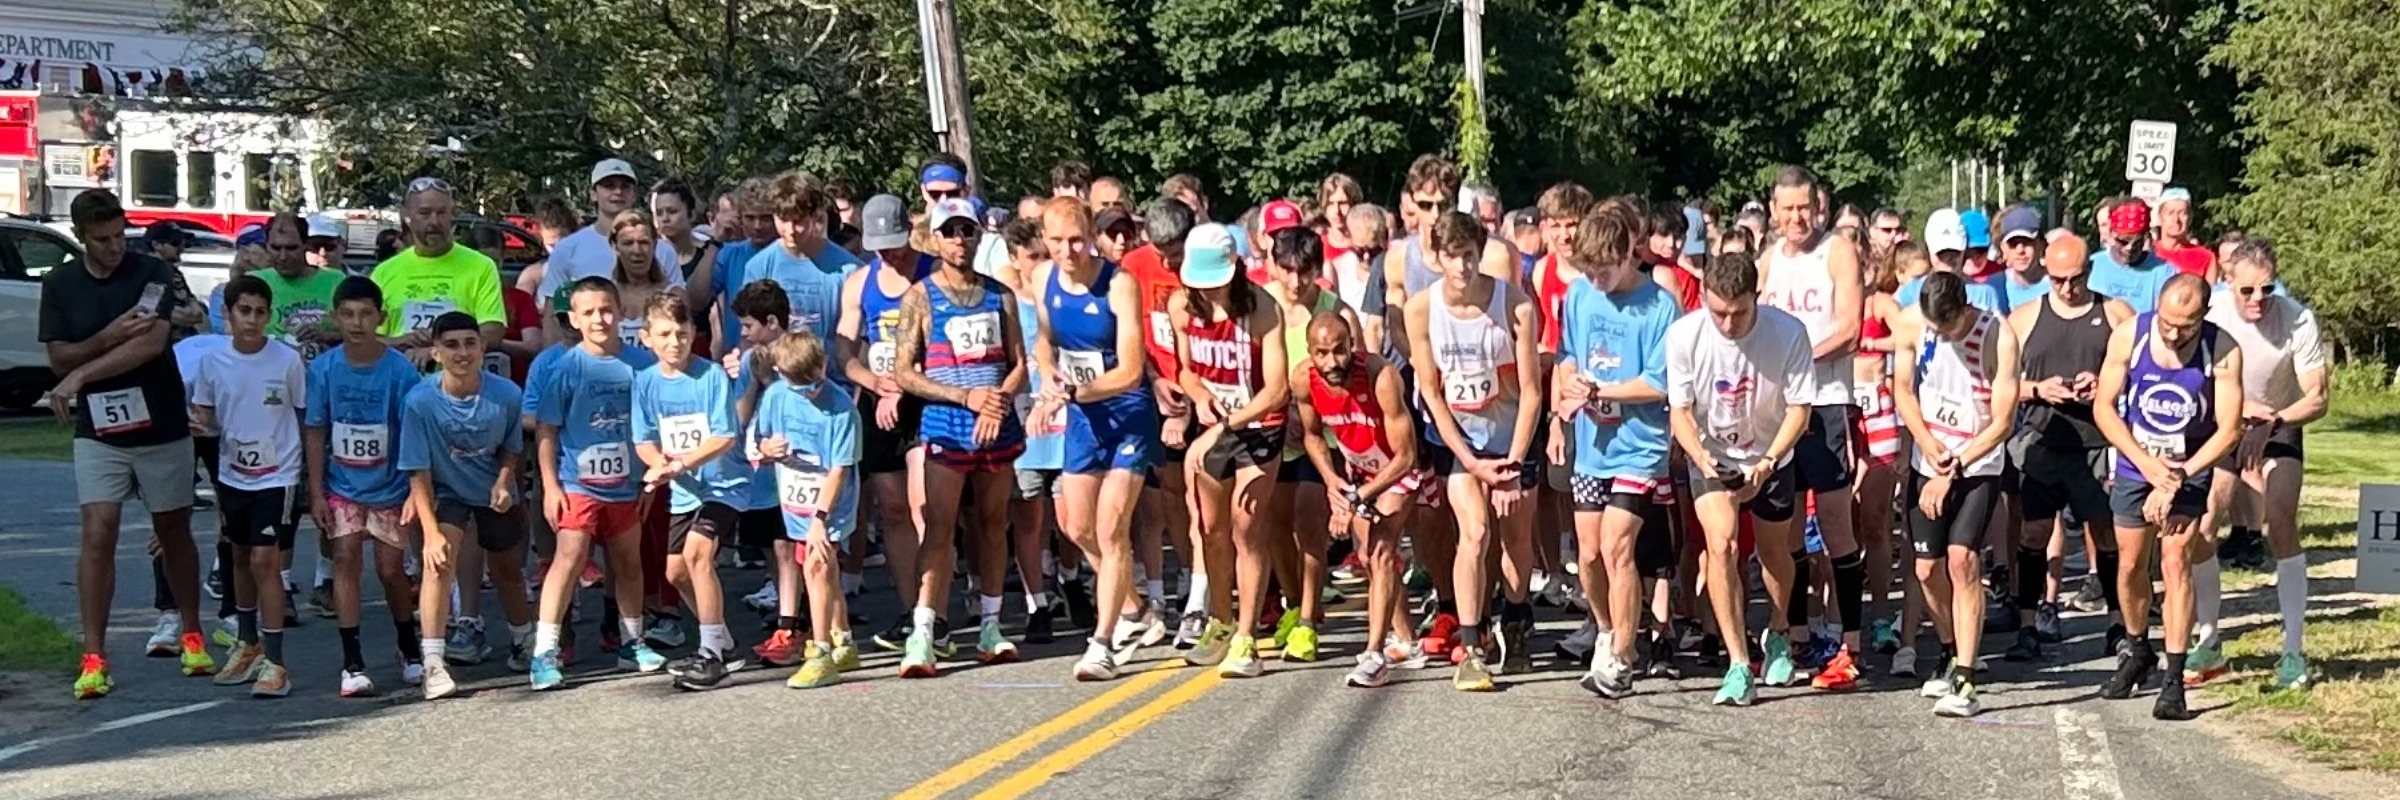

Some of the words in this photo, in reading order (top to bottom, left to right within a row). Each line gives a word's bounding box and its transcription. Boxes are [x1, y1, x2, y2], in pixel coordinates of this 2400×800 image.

[2136, 128, 2170, 140] SPEED
[2137, 140, 2166, 151] LIMIT
[2133, 152, 2168, 175] 30
[960, 327, 996, 350] 342
[1189, 335, 1252, 370] NOTCH
[1453, 379, 1492, 401] 219
[104, 403, 131, 424] 51
[1935, 405, 1959, 427] 46
[341, 437, 381, 457] 188
[669, 428, 703, 450] 129
[236, 450, 262, 467] 42
[588, 456, 624, 475] 103
[786, 484, 822, 505] 267
